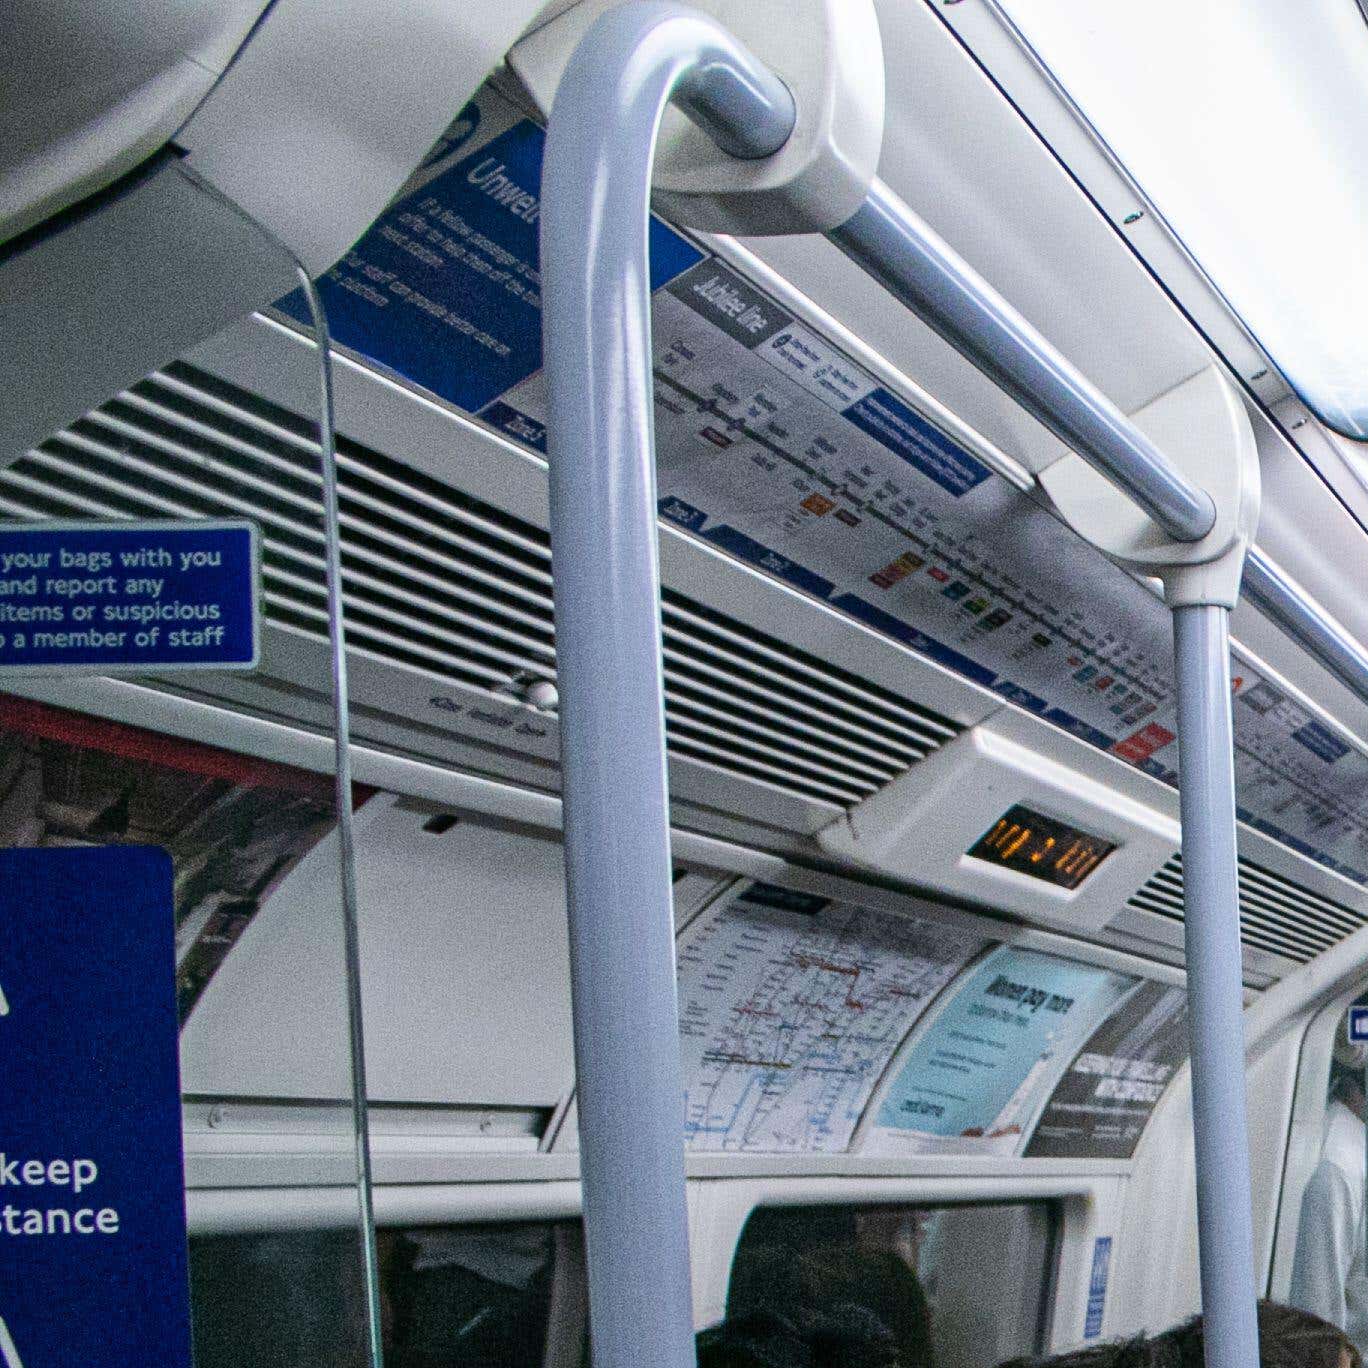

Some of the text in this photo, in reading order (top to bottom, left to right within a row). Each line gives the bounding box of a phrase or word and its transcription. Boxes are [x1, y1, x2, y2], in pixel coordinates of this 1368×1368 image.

[693, 276, 769, 334] Jubilee line
[2, 548, 222, 572] your bags with you
[0, 576, 164, 598] and report any
[72, 605, 95, 621] or
[103, 601, 220, 623] suspicious
[14, 626, 225, 648] a member of staff
[0, 1152, 98, 1193] keep
[2, 1205, 120, 1235] tance
